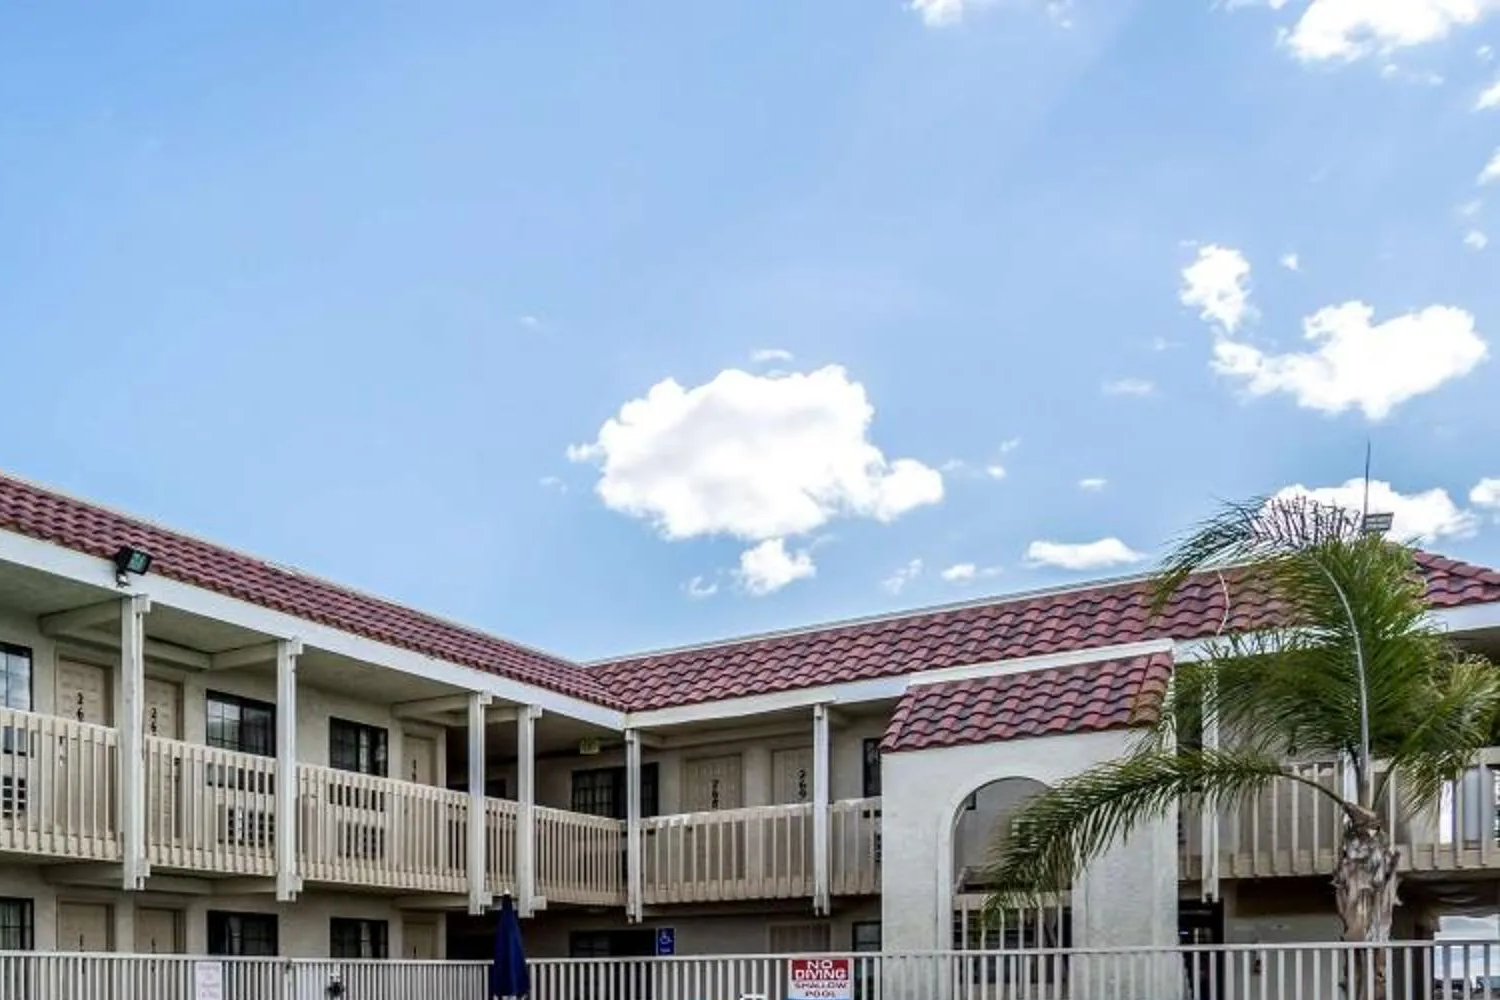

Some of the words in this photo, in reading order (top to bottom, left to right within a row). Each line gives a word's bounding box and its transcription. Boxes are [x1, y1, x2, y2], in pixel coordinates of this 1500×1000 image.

[150, 707, 158, 736] 26
[807, 959, 833, 969] NO
[795, 968, 846, 979] DIVING
[795, 981, 847, 989] SHALLOW
[805, 990, 836, 998] POOL
